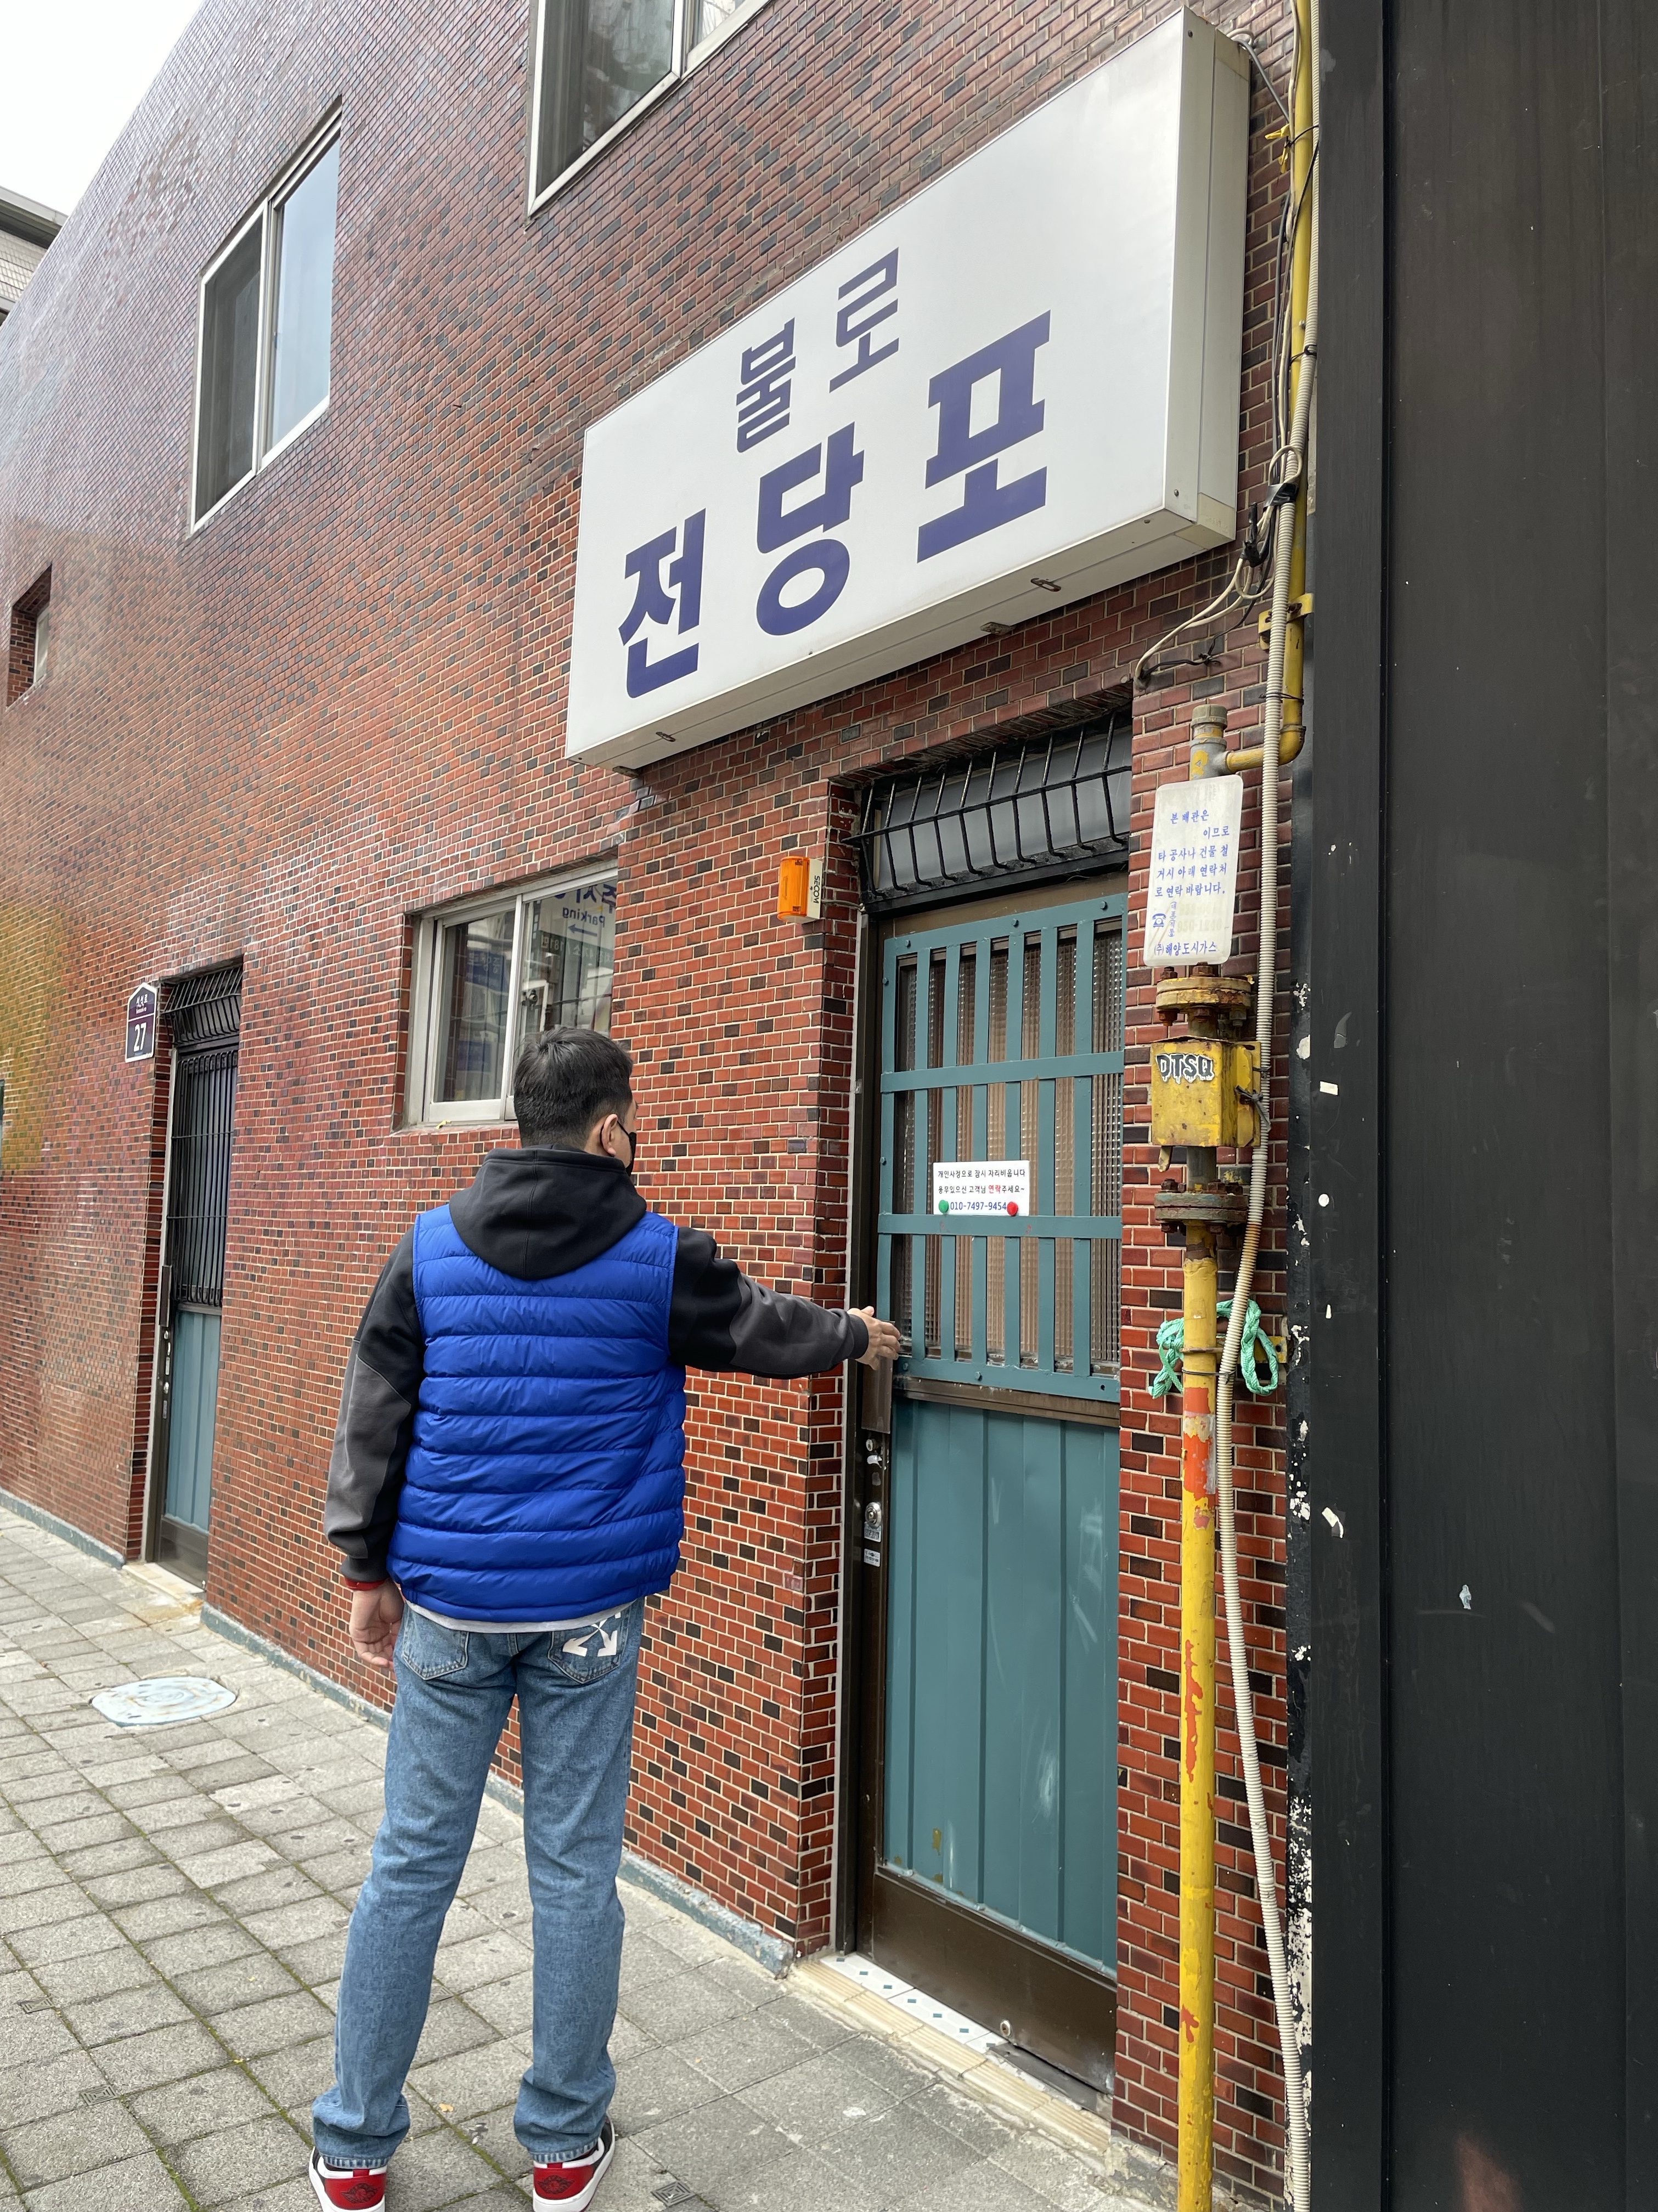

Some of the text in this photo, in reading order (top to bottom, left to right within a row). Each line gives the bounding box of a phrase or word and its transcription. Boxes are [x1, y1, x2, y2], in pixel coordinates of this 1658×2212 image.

[736, 247, 899, 453] 불로
[618, 309, 1051, 698] 전당포
[1170, 809, 1209, 824] 본 배관은
[1203, 826, 1230, 839] 이므로
[1158, 844, 1228, 862] 타 공사나 건물 철
[1157, 862, 1227, 880] 거시 아래 연락처
[1155, 882, 1225, 898] 로 연락 바랍니다.
[1154, 940, 1216, 956] (주)해양도시가스
[133, 1022, 146, 1052] 27
[938, 1170, 973, 1178] 개인사정으로
[974, 1170, 986, 1178] 잠시
[938, 1186, 967, 1194] 용무있으신
[969, 1186, 986, 1194] 고객님
[950, 1201, 1007, 1210] 010-7497-9454
